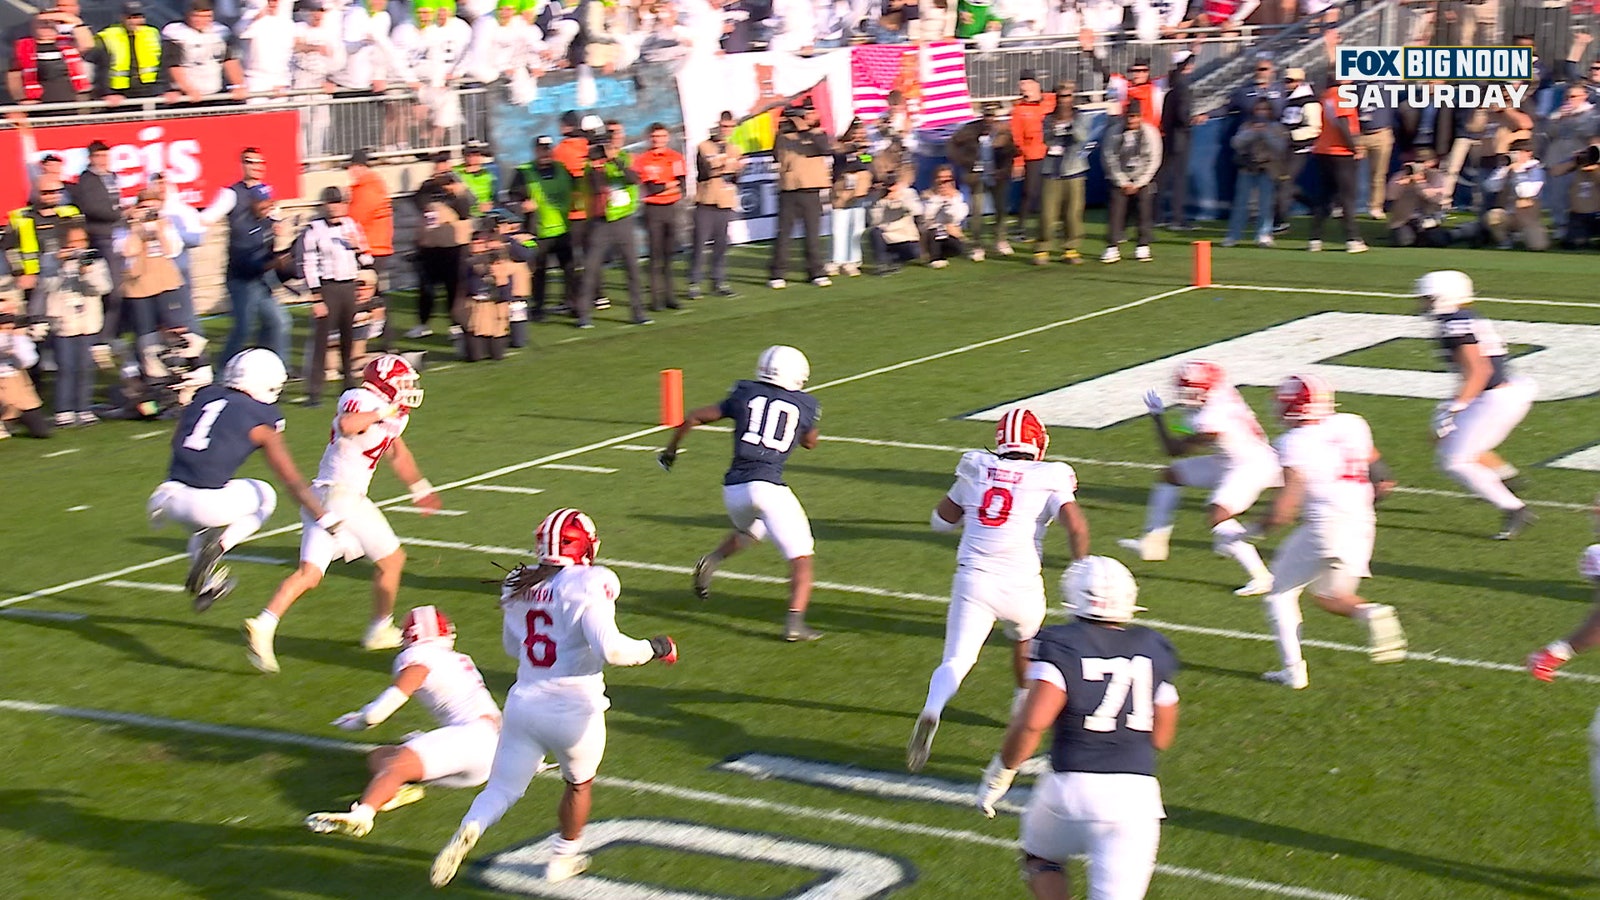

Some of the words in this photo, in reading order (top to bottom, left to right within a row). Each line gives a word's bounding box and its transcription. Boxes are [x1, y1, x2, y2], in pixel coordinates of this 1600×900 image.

[183, 398, 229, 451] 1
[741, 395, 800, 453] 10
[978, 486, 1013, 527] 0
[523, 608, 557, 668] 6
[1080, 654, 1154, 732] 71
